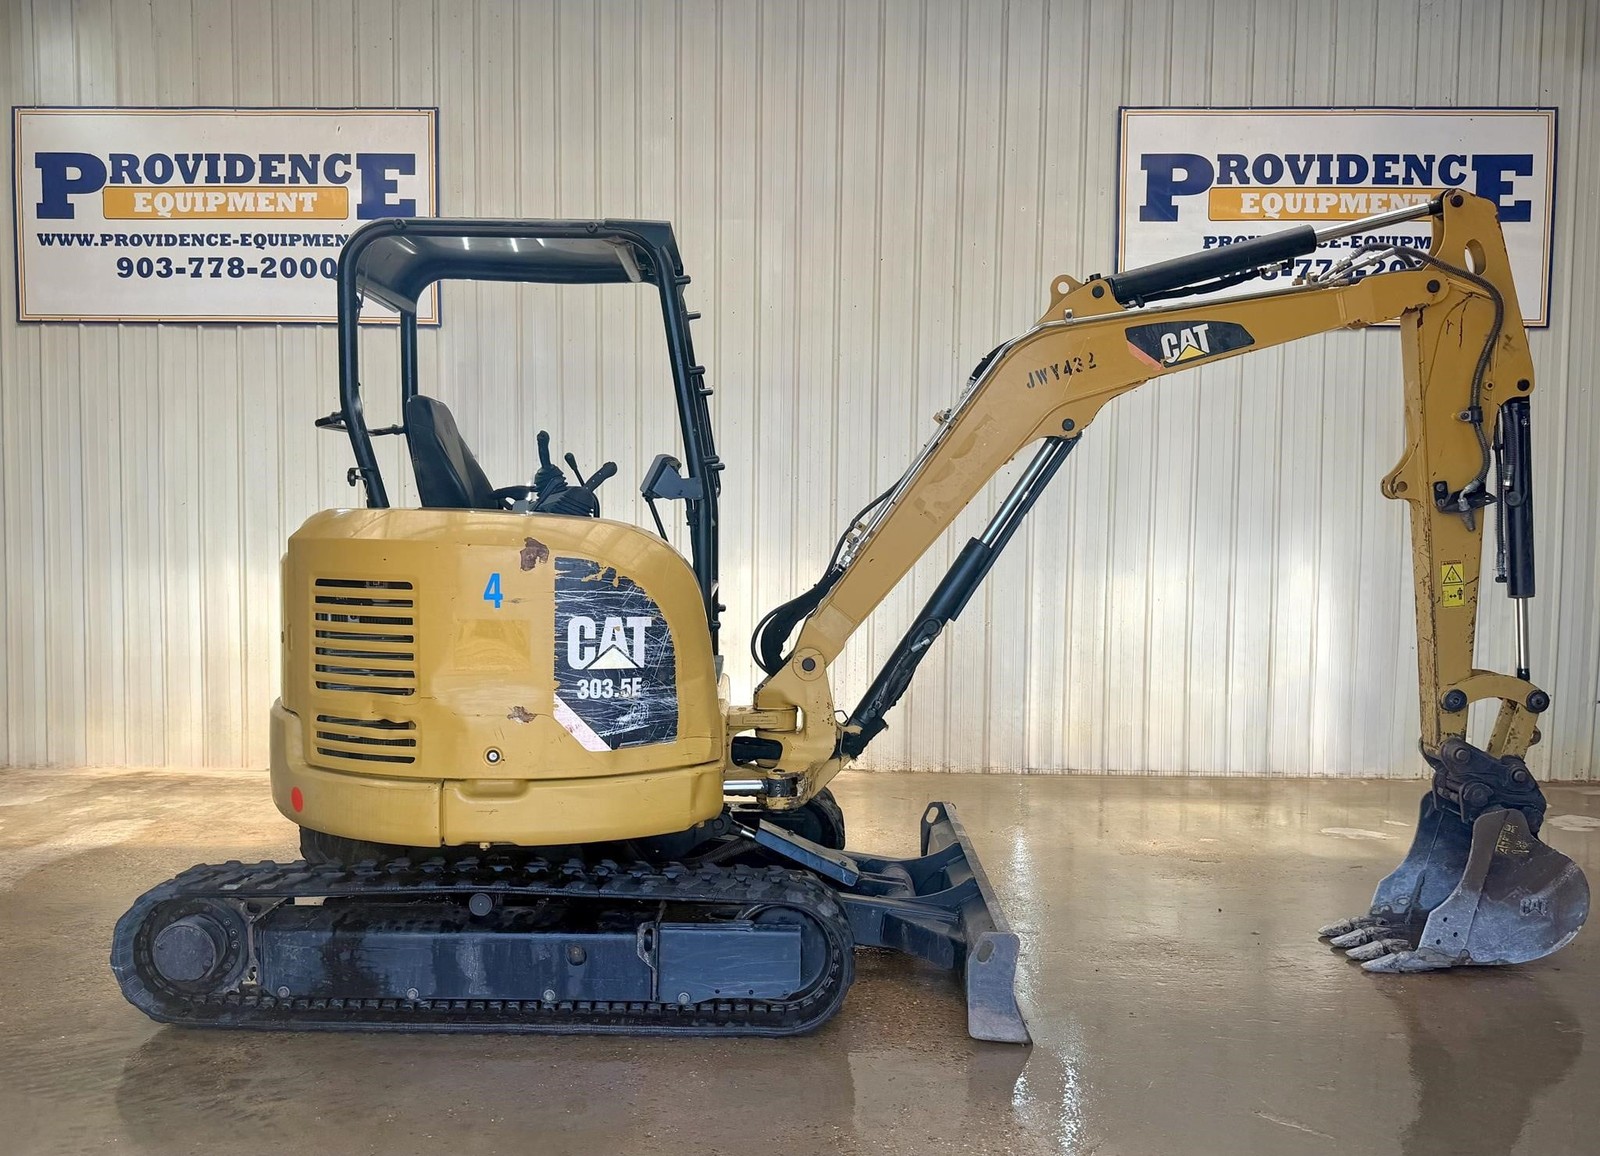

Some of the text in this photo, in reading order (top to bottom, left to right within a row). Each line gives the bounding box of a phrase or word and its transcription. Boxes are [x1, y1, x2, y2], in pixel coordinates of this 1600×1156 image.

[35, 152, 416, 220] PROVIDENCE
[133, 191, 318, 218] EQUIPMENT
[1140, 153, 1533, 222] PROVIDENCE
[117, 257, 337, 279] 903-778-2000
[1160, 323, 1211, 364] CAT
[1026, 352, 1097, 389] JWY432
[483, 573, 504, 609] 4
[567, 616, 652, 670] CAT
[1519, 896, 1548, 917] CAT
